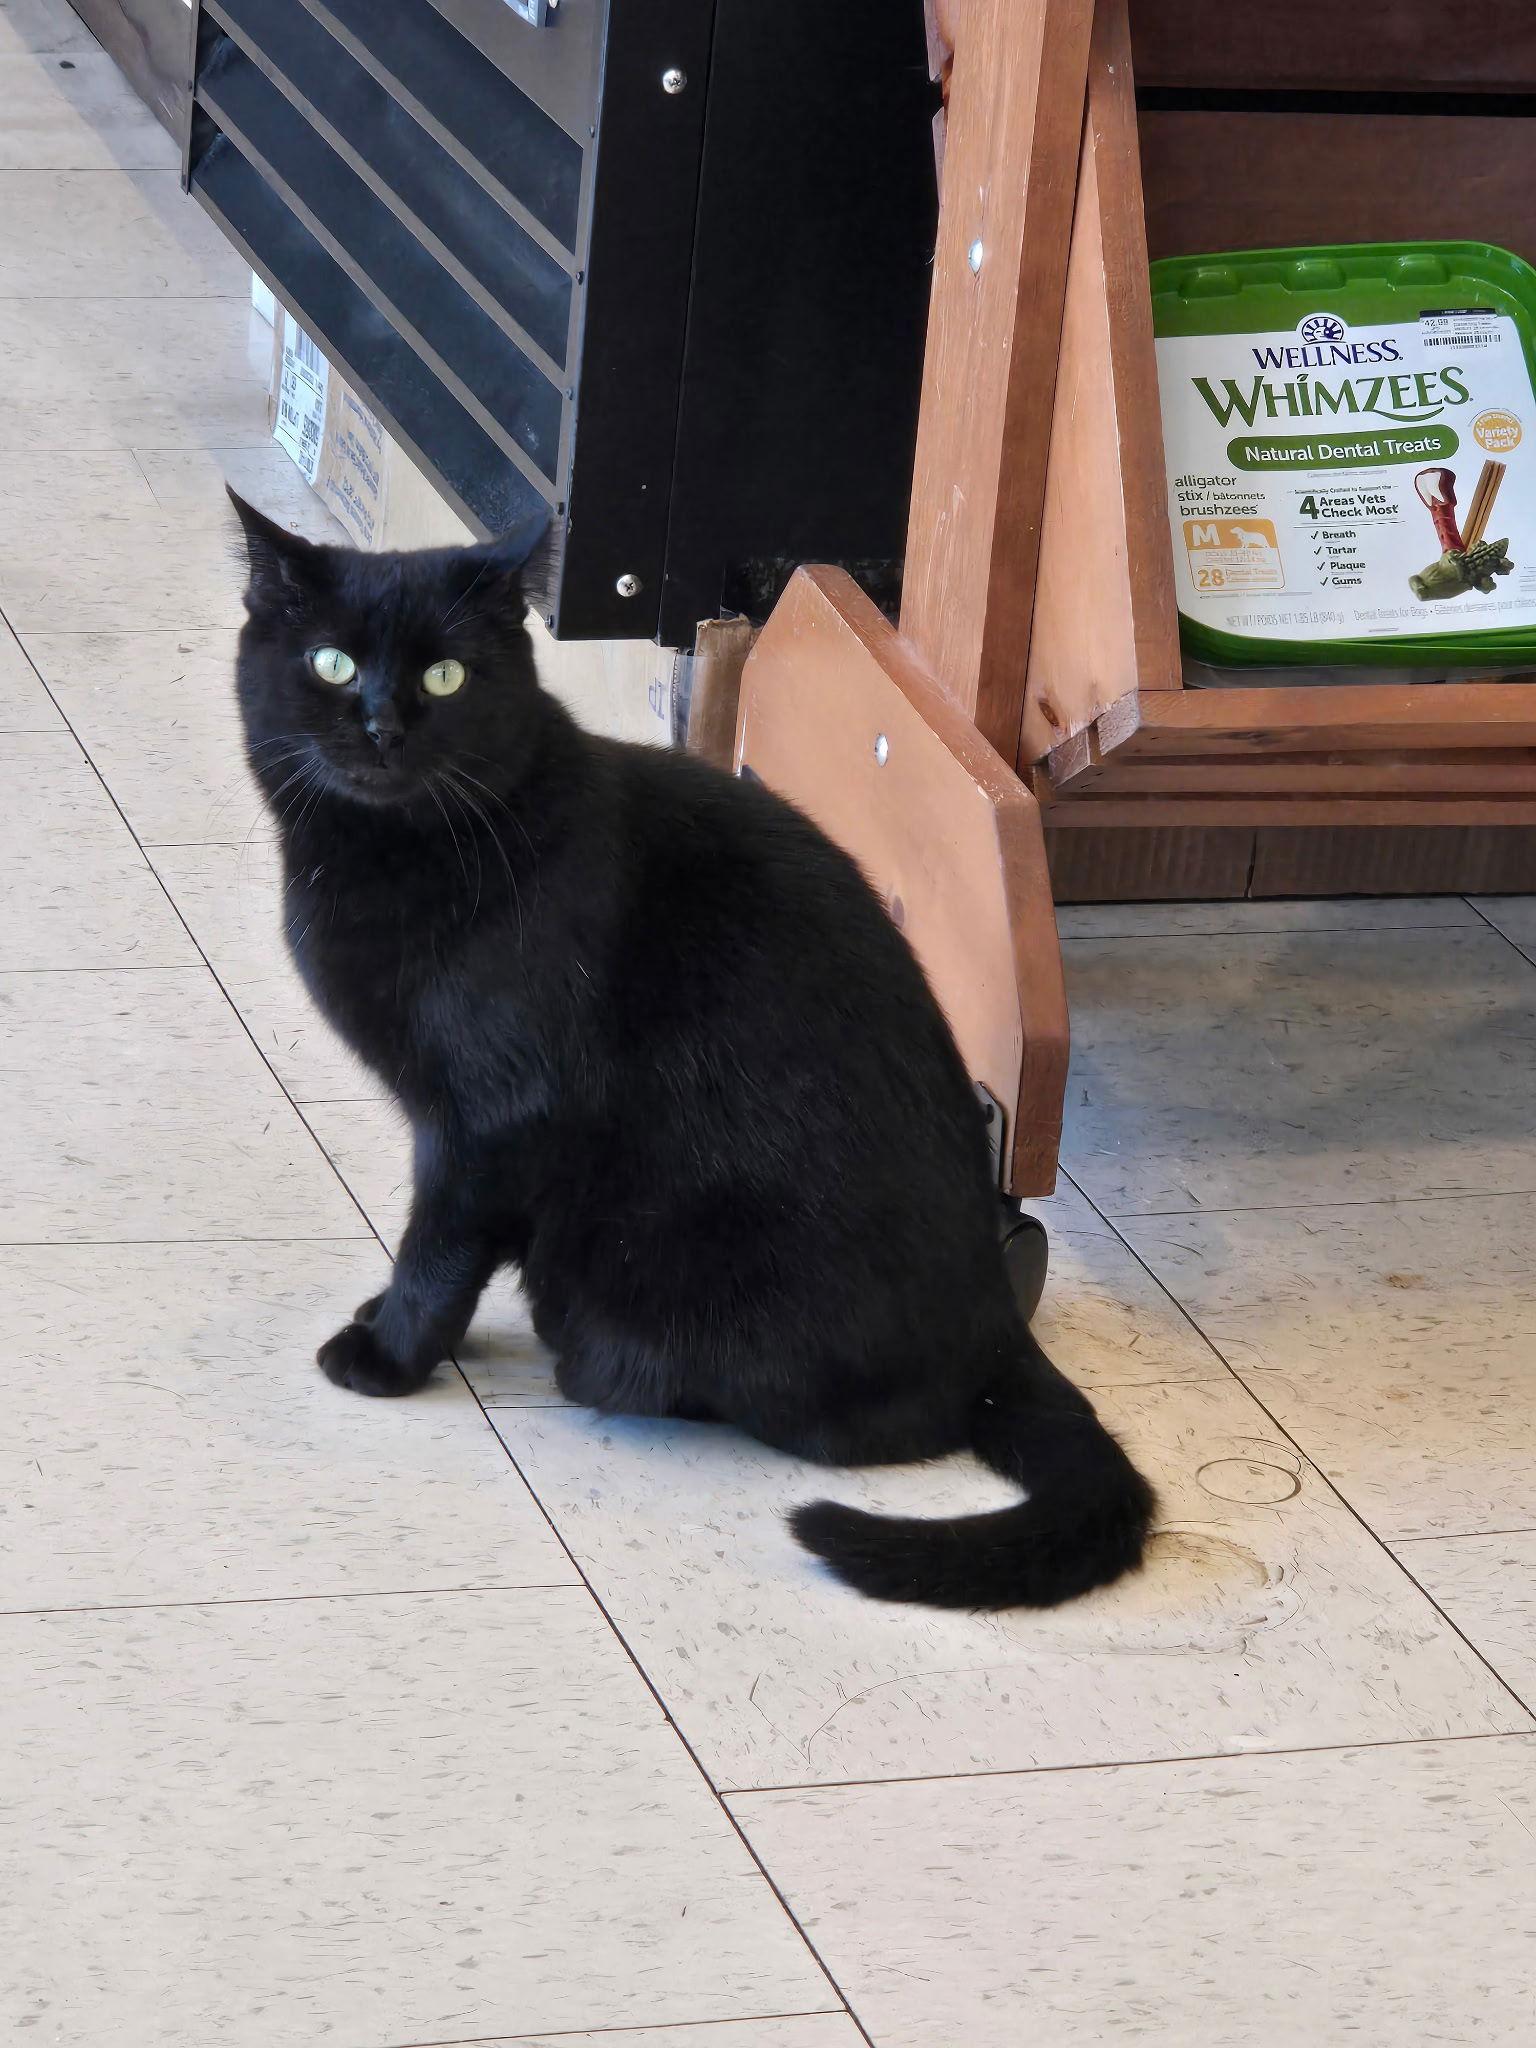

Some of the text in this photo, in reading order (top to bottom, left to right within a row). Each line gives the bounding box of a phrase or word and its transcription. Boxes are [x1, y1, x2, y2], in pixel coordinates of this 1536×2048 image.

[1252, 339, 1401, 370] WELLNESS
[1191, 366, 1471, 428] WHIMZEES
[1475, 425, 1518, 439] Variety
[1245, 436, 1441, 462] Natural Dental Treats
[1485, 437, 1515, 450] Pack
[1175, 475, 1237, 488] alligator
[1177, 490, 1204, 501] stix
[1180, 504, 1258, 516] brushzees
[1299, 494, 1386, 519] 4 Areas Vets
[1321, 507, 1363, 518] Check
[1192, 523, 1221, 546] M
[1322, 530, 1356, 539] Breath
[1326, 546, 1357, 555] Tartar
[1330, 561, 1366, 571] Plaque
[1198, 568, 1225, 587] 28
[1332, 576, 1362, 585] Gums
